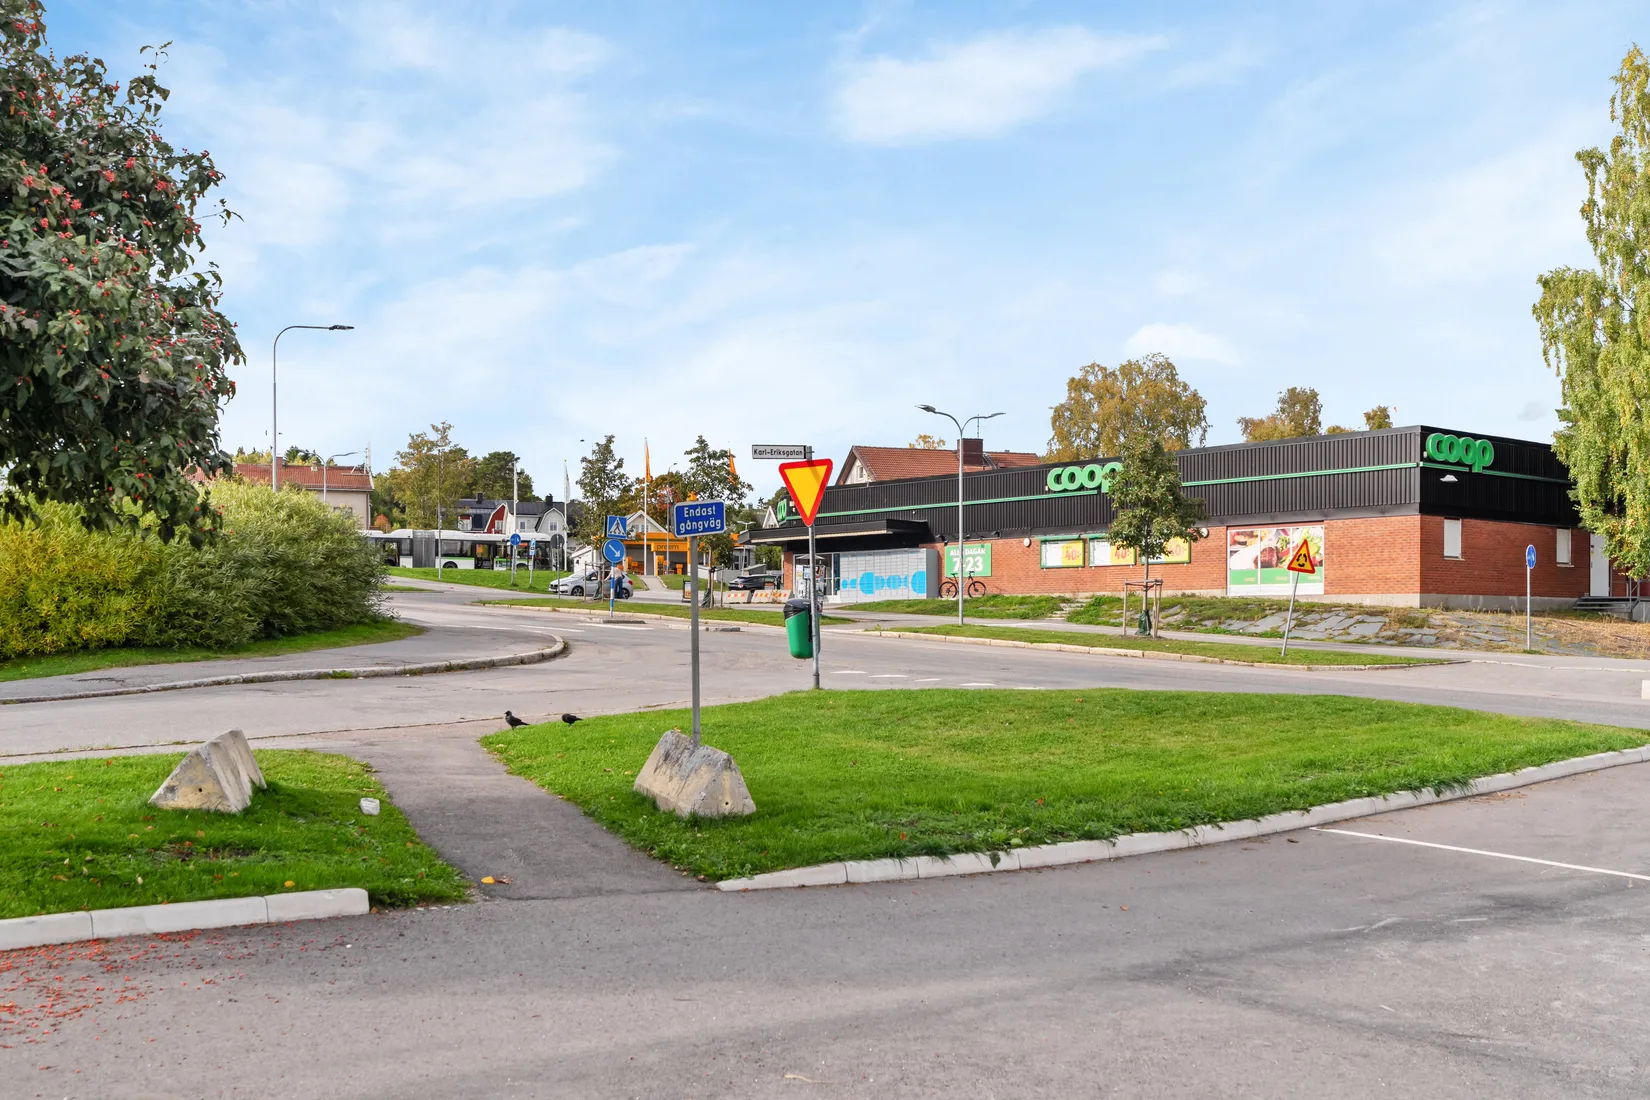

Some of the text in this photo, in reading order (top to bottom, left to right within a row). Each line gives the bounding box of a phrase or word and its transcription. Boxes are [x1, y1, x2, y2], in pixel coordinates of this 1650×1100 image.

[753, 448, 803, 457] Karl-Eriksgatan
[1426, 433, 1494, 472] coop
[1047, 462, 1124, 493] coop
[684, 506, 716, 517] Endast
[679, 517, 721, 534] gångväg
